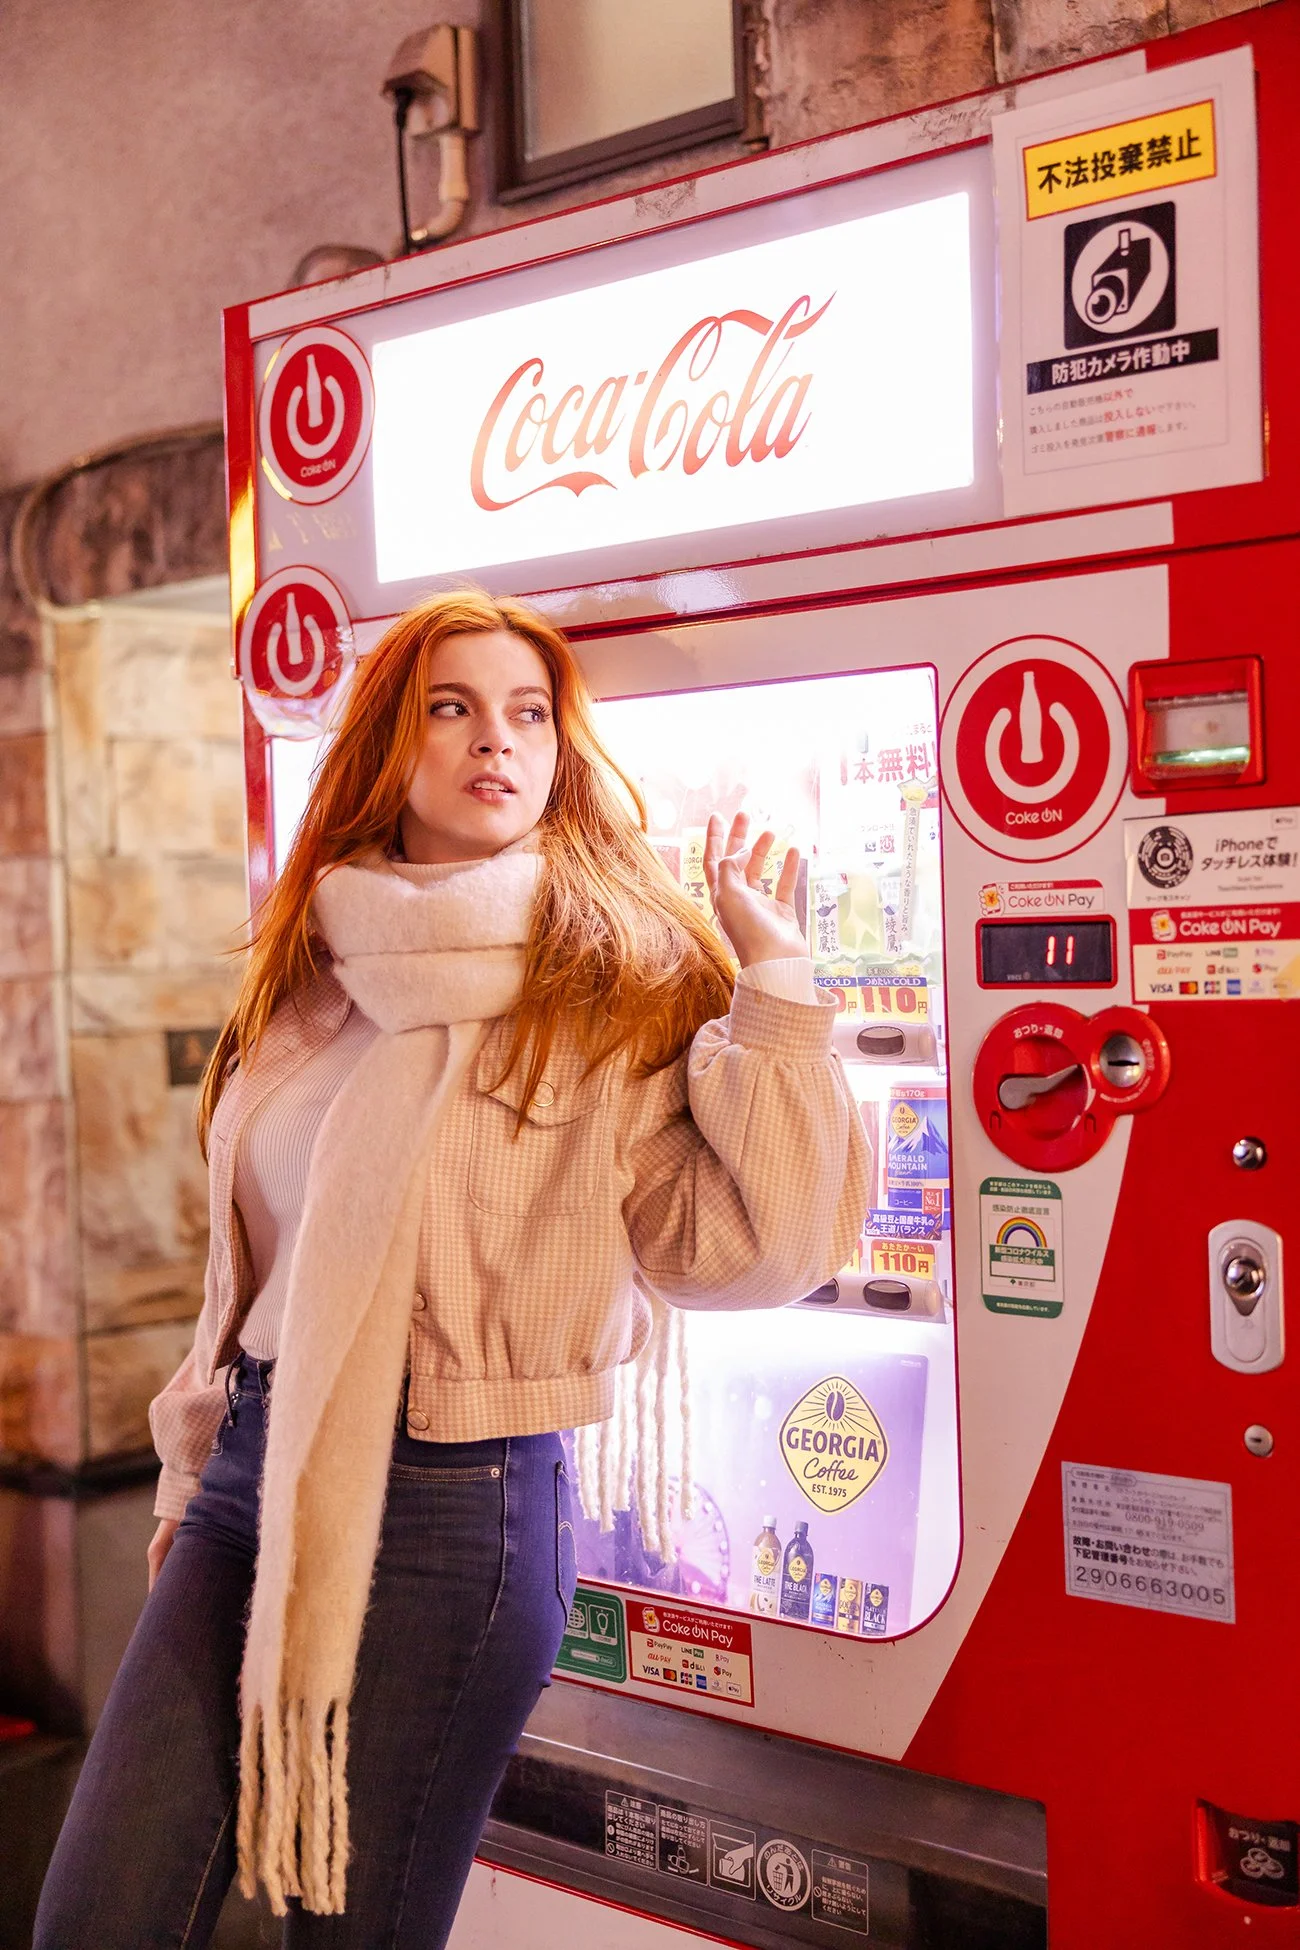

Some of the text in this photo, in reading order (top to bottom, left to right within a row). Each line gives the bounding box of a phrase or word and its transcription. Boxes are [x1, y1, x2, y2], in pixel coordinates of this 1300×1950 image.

[1037, 128, 1202, 194] 不法投棄禁止
[1051, 339, 1191, 385] 防犯カメラ作動中
[470, 290, 838, 512] Coca-Cola
[1005, 808, 1063, 825] Coke ON
[1215, 836, 1279, 853] iPhoneで
[1008, 893, 1095, 908] Coke ON Pay
[1179, 917, 1281, 938] Coke ON Pay
[823, 979, 851, 987] COLD
[892, 978, 921, 987] COLD
[1149, 984, 1174, 994] VISA
[888, 1154, 925, 1163] EMERALD
[872, 1213, 935, 1226] 高級豆と国産牛乳の
[880, 1224, 926, 1235] 王道バランス
[785, 1425, 881, 1463] GEORGIA
[803, 1457, 859, 1482] Coffee
[1076, 1565, 1226, 1605] 2906663005
[864, 1611, 886, 1625] BLACK
[662, 1620, 734, 1648] Coke ON Pay
[653, 1642, 673, 1651] PayPay
[681, 1647, 692, 1655] LINE
[642, 1665, 660, 1677] VISA
[766, 1885, 802, 1907] リサイクル
